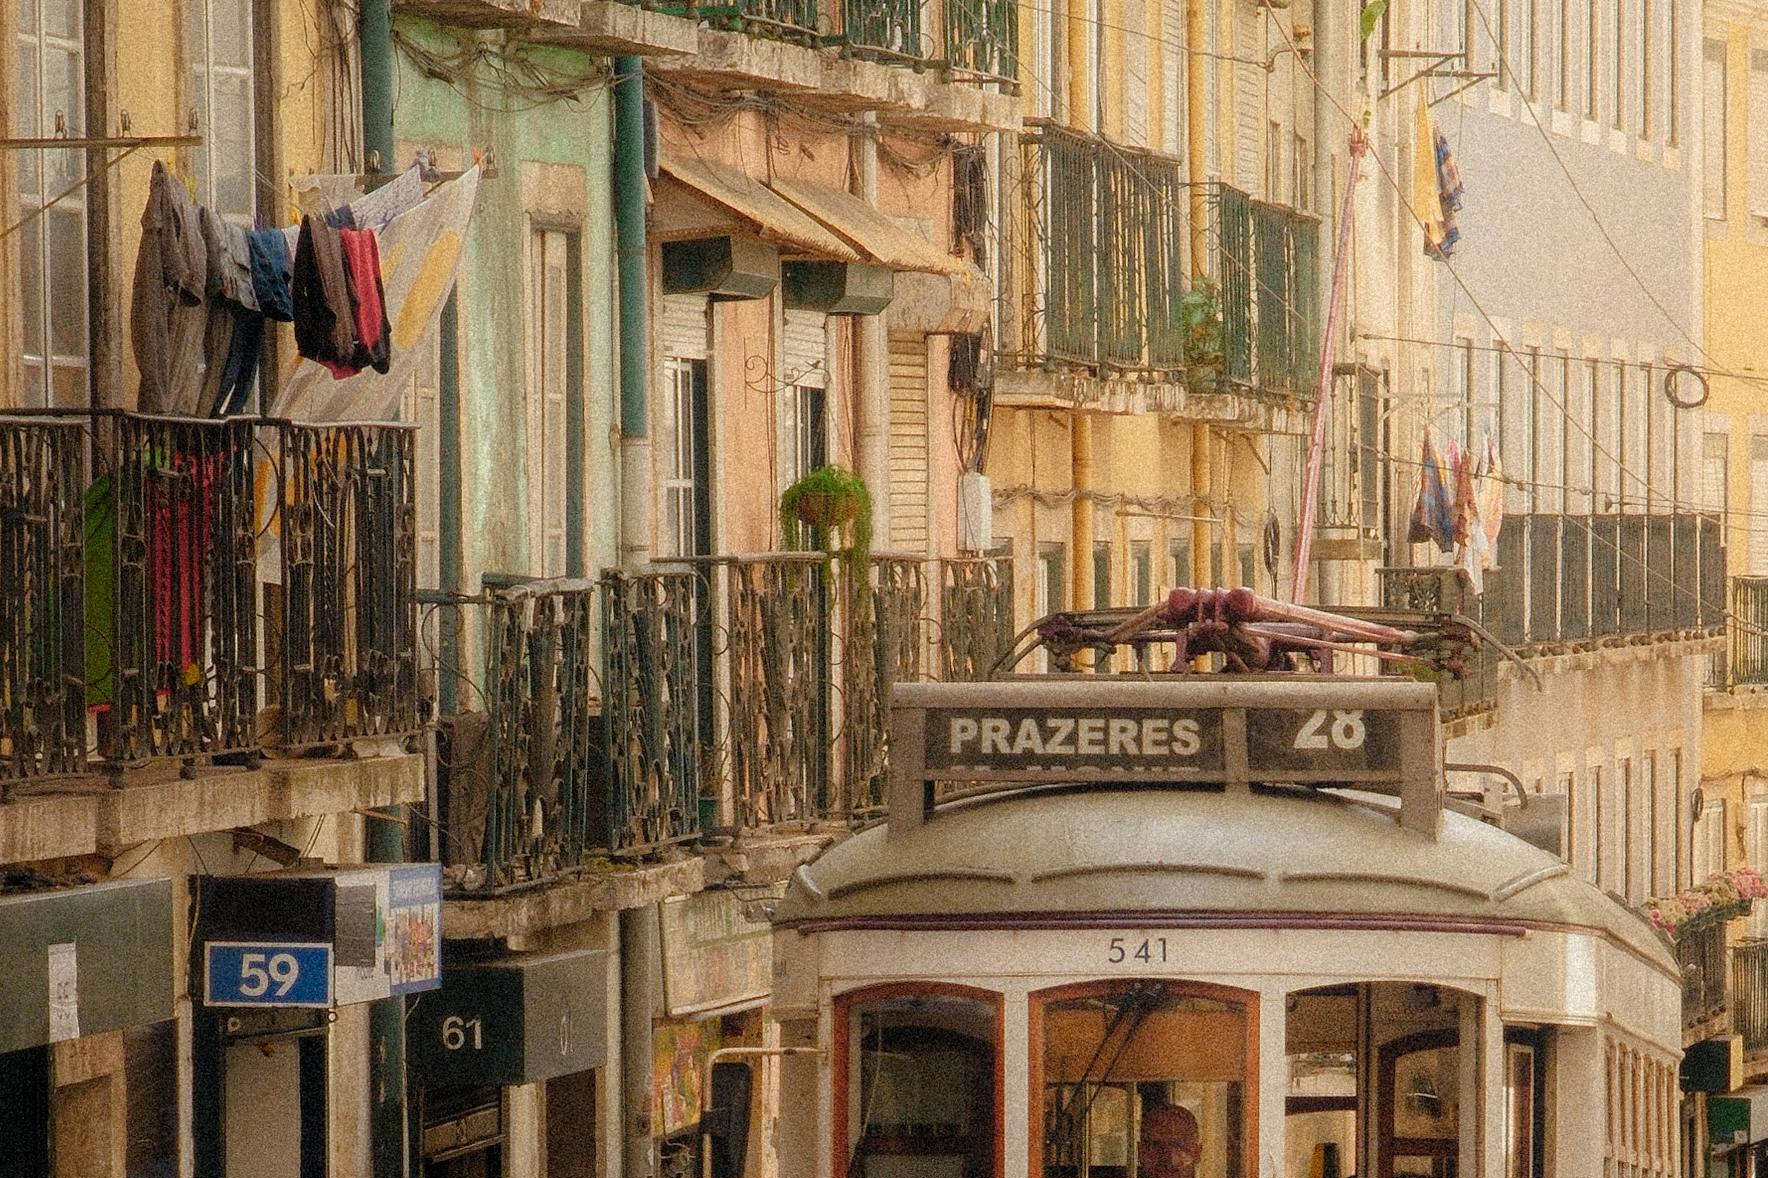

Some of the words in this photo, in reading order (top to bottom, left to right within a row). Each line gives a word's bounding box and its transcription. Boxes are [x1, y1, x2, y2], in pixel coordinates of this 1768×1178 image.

[949, 718, 1202, 756] PRAZERES
[1293, 709, 1366, 749] 28
[1108, 938, 1167, 964] 541
[239, 953, 300, 997] 59
[442, 1015, 483, 1050] 61
